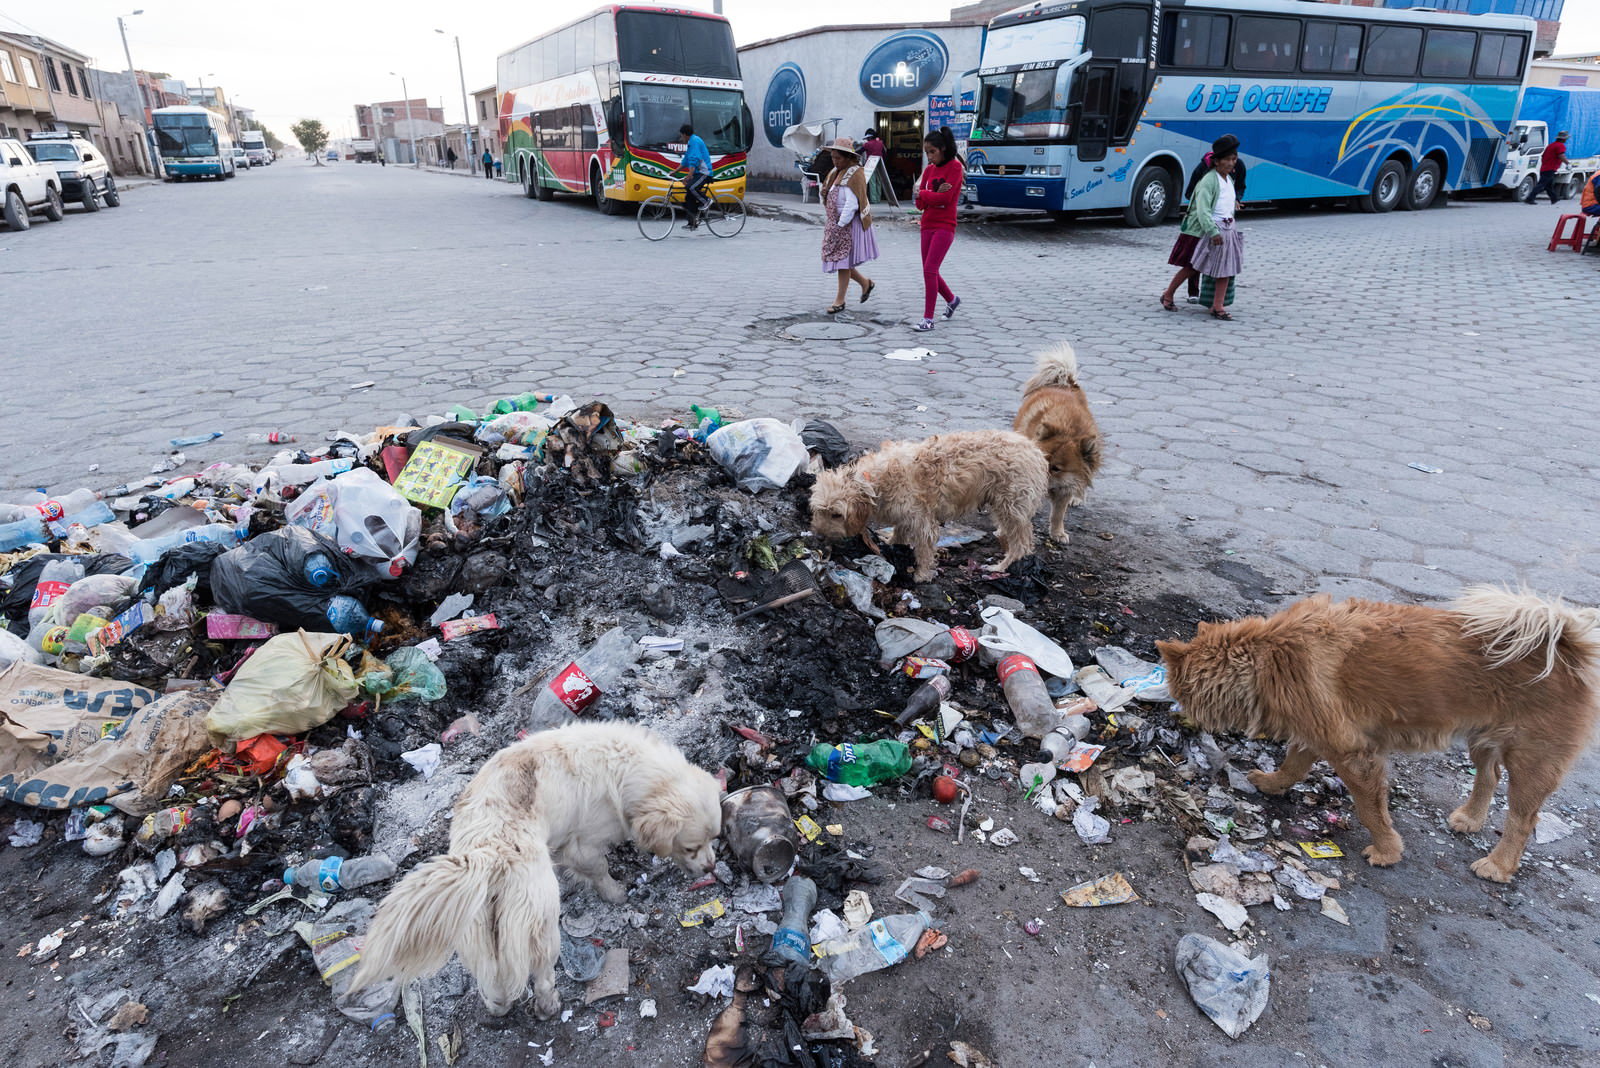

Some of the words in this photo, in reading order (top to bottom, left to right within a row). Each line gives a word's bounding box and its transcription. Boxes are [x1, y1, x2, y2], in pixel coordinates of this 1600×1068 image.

[1150, 35, 1158, 62] JUM
[870, 66, 920, 88] entel
[947, 99, 975, 109] Obre
[1186, 84, 1205, 112] 6
[1205, 84, 1241, 113] DE
[768, 103, 793, 127] entel
[667, 143, 689, 153] UYUN
[843, 741, 856, 764] Spri
